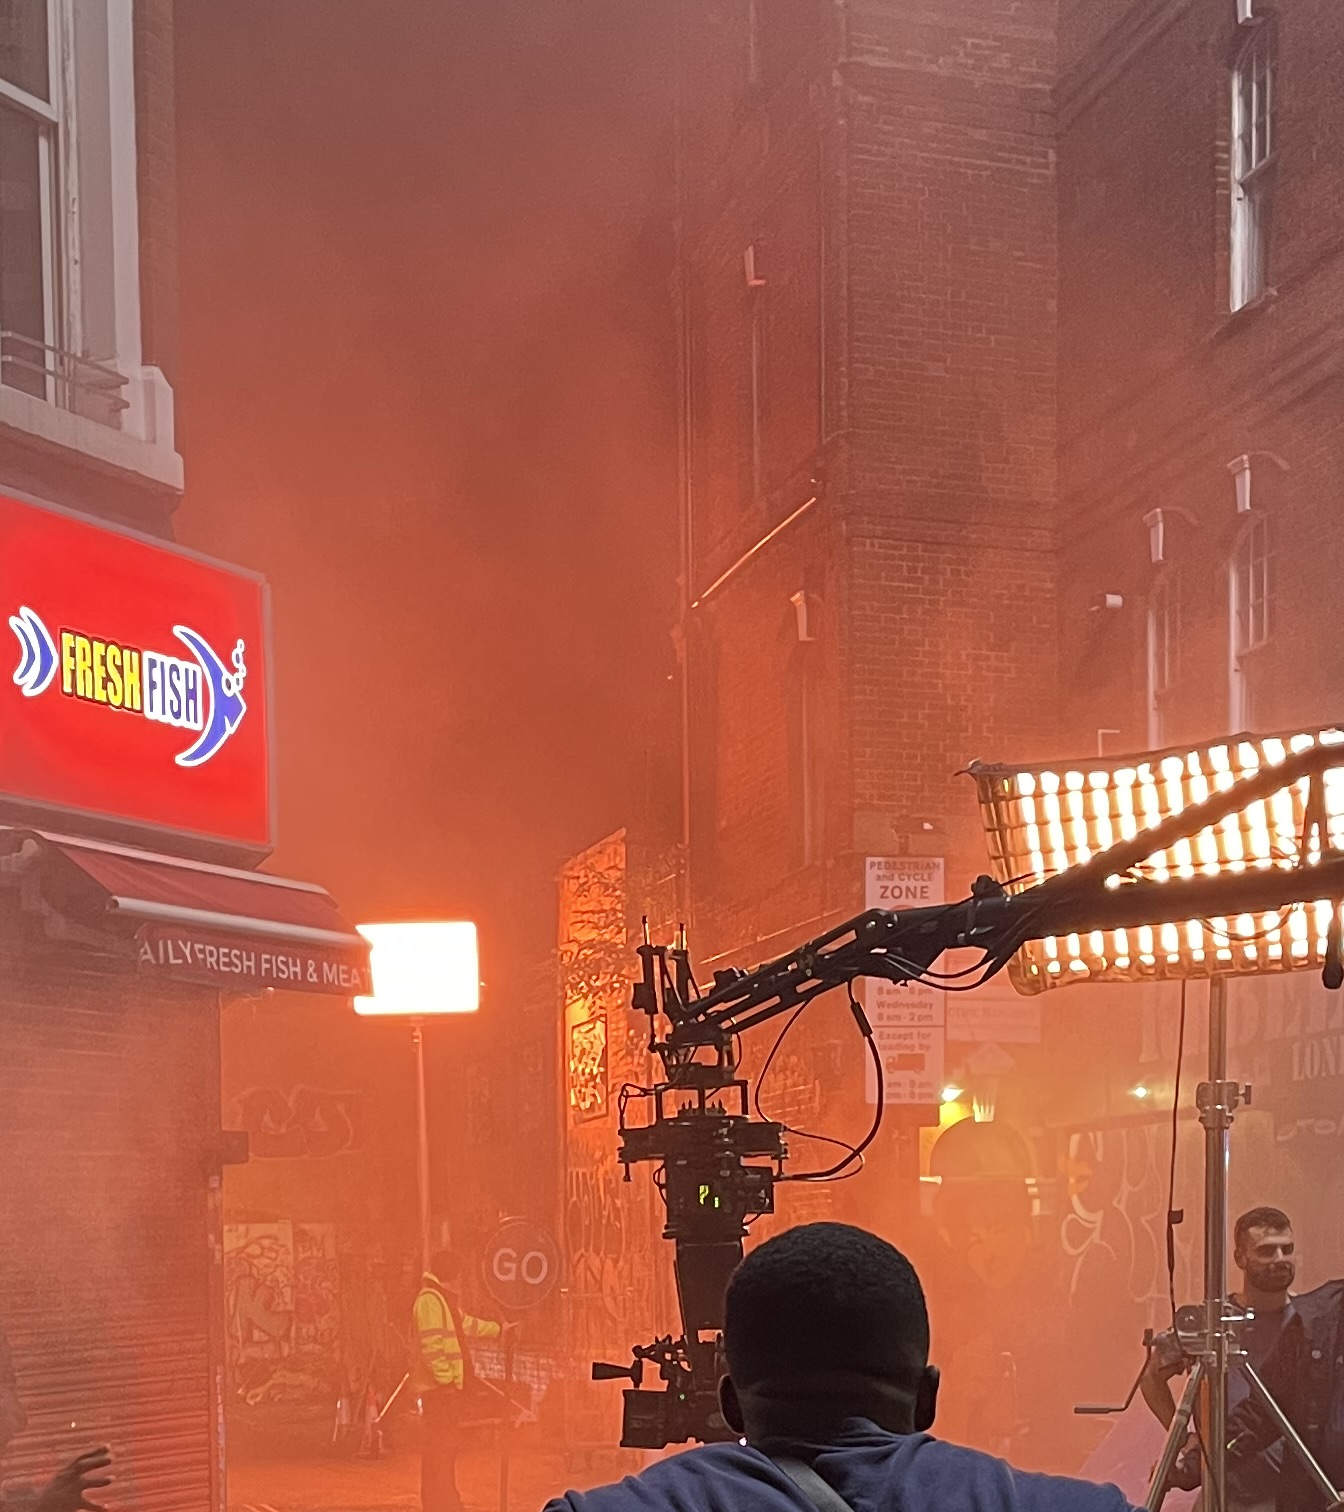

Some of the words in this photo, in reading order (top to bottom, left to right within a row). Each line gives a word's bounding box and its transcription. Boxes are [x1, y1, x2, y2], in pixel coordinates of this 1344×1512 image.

[60, 628, 143, 713] FRESH
[143, 651, 203, 731] FISH
[869, 861, 941, 871] PEDESTRIAN
[876, 872, 894, 882] and
[898, 872, 934, 882] CYCLE
[879, 885, 930, 900] ZONE
[139, 939, 193, 965] AILY
[194, 943, 256, 977] FRESH
[261, 953, 302, 981] FISH
[307, 959, 318, 983] &
[876, 1000, 934, 1010] Wednesday
[878, 1031, 914, 1041] Except
[492, 1247, 548, 1285] GO
